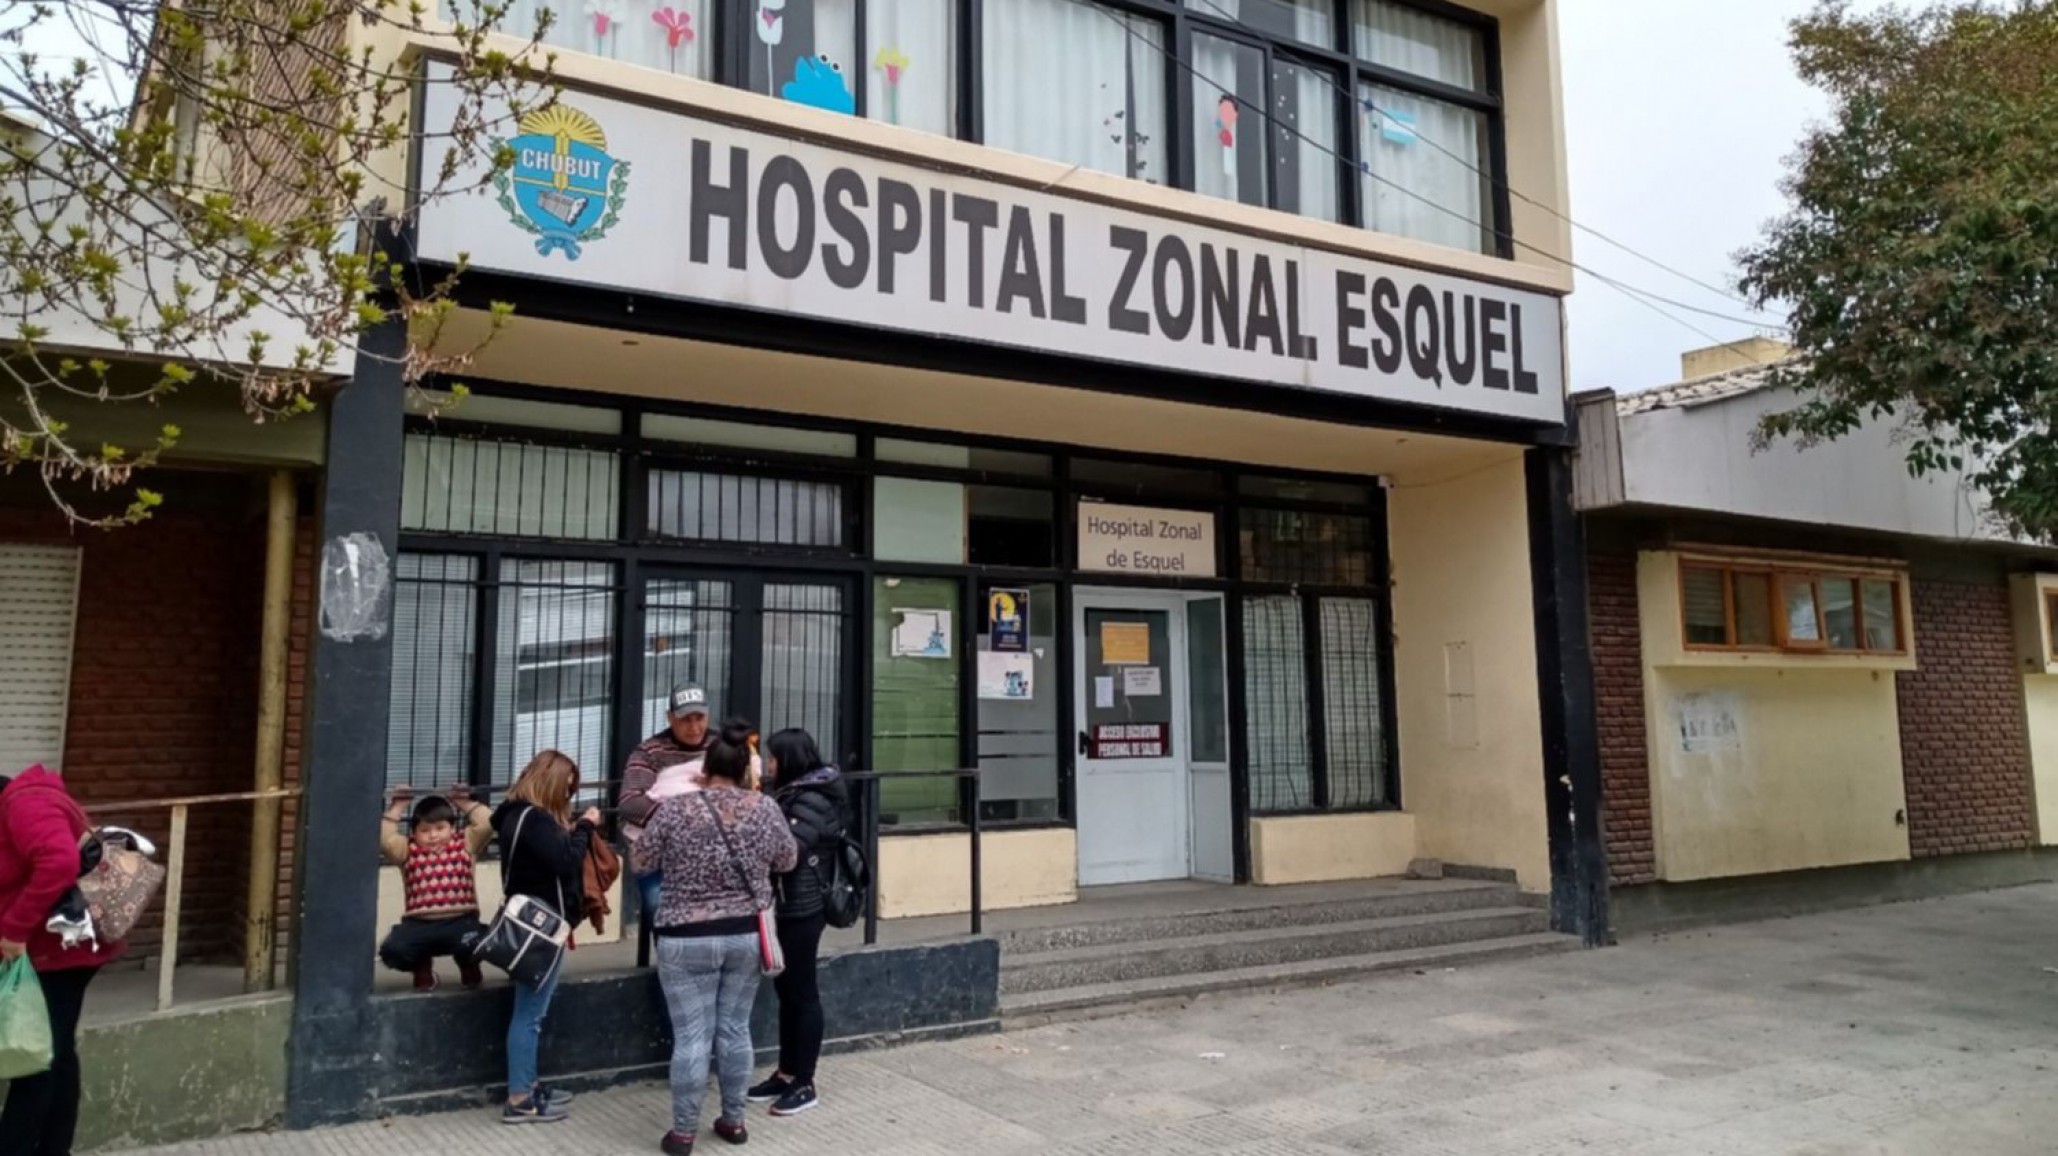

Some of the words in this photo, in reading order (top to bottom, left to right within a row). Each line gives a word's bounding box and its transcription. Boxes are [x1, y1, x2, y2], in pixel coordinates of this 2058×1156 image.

[522, 149, 602, 180] CHUBUT
[689, 138, 1086, 325] HOSPITAL
[1108, 224, 1318, 362] ZONAL
[1335, 269, 1539, 395] ESQUEL
[1087, 515, 1153, 540] Hospital
[1159, 521, 1202, 541] Zonal
[1106, 548, 1127, 568] de
[1133, 551, 1184, 575] Esquel
